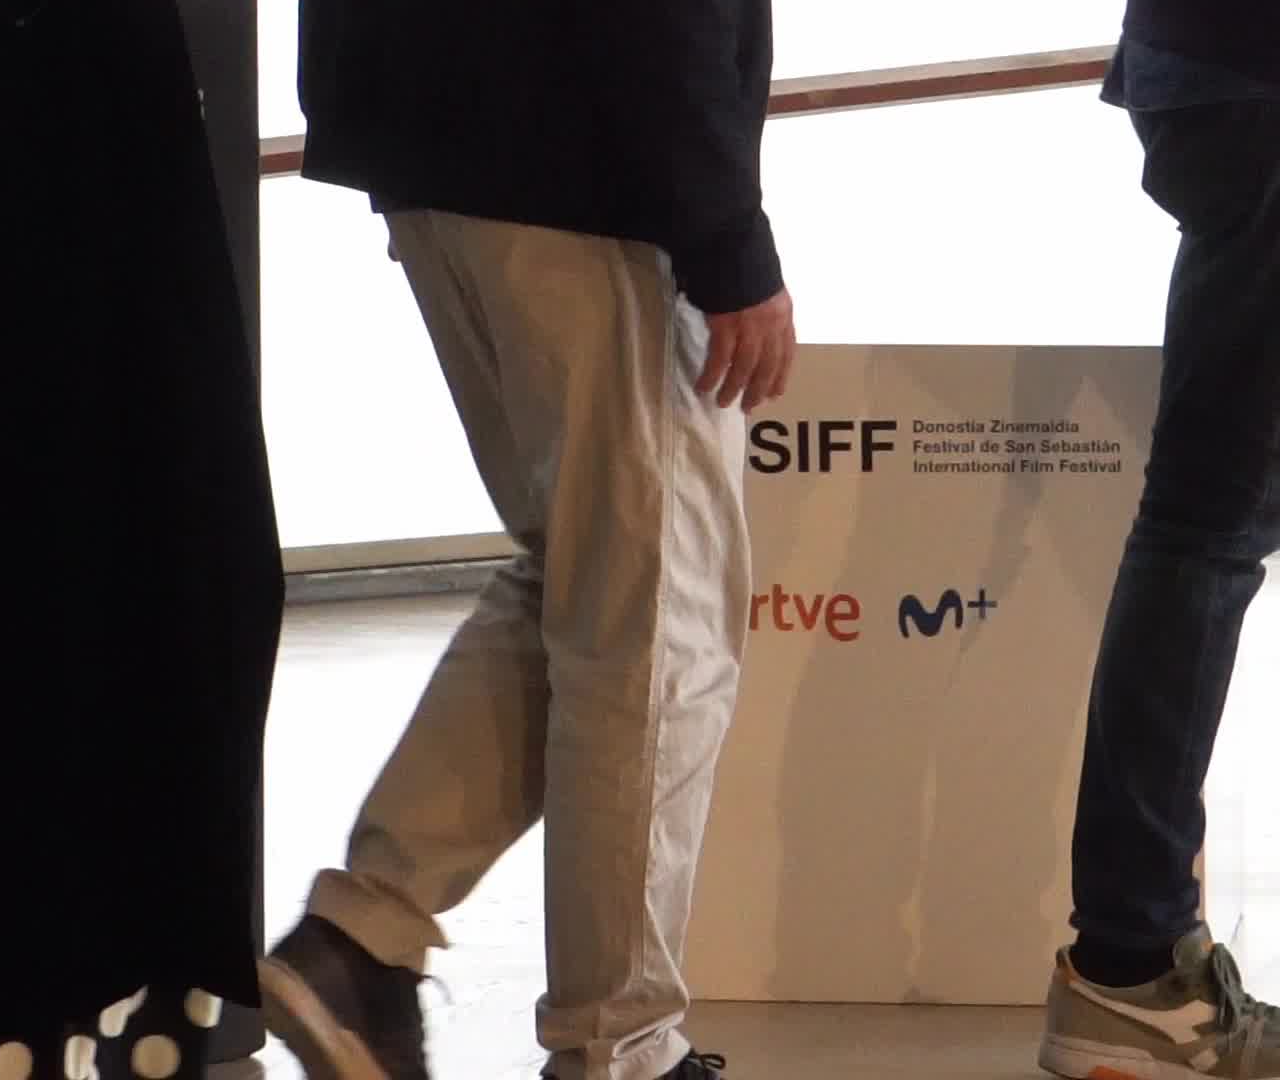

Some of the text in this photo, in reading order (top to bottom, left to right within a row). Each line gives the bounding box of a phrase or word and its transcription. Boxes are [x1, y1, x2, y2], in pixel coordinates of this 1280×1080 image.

[913, 420, 1080, 434] Donostia Zinemaldia
[749, 420, 897, 474] SIFF
[913, 438, 1121, 454] Festival de San Sebastián
[913, 458, 1122, 474] International Film Festival
[749, 583, 862, 642] rtve
